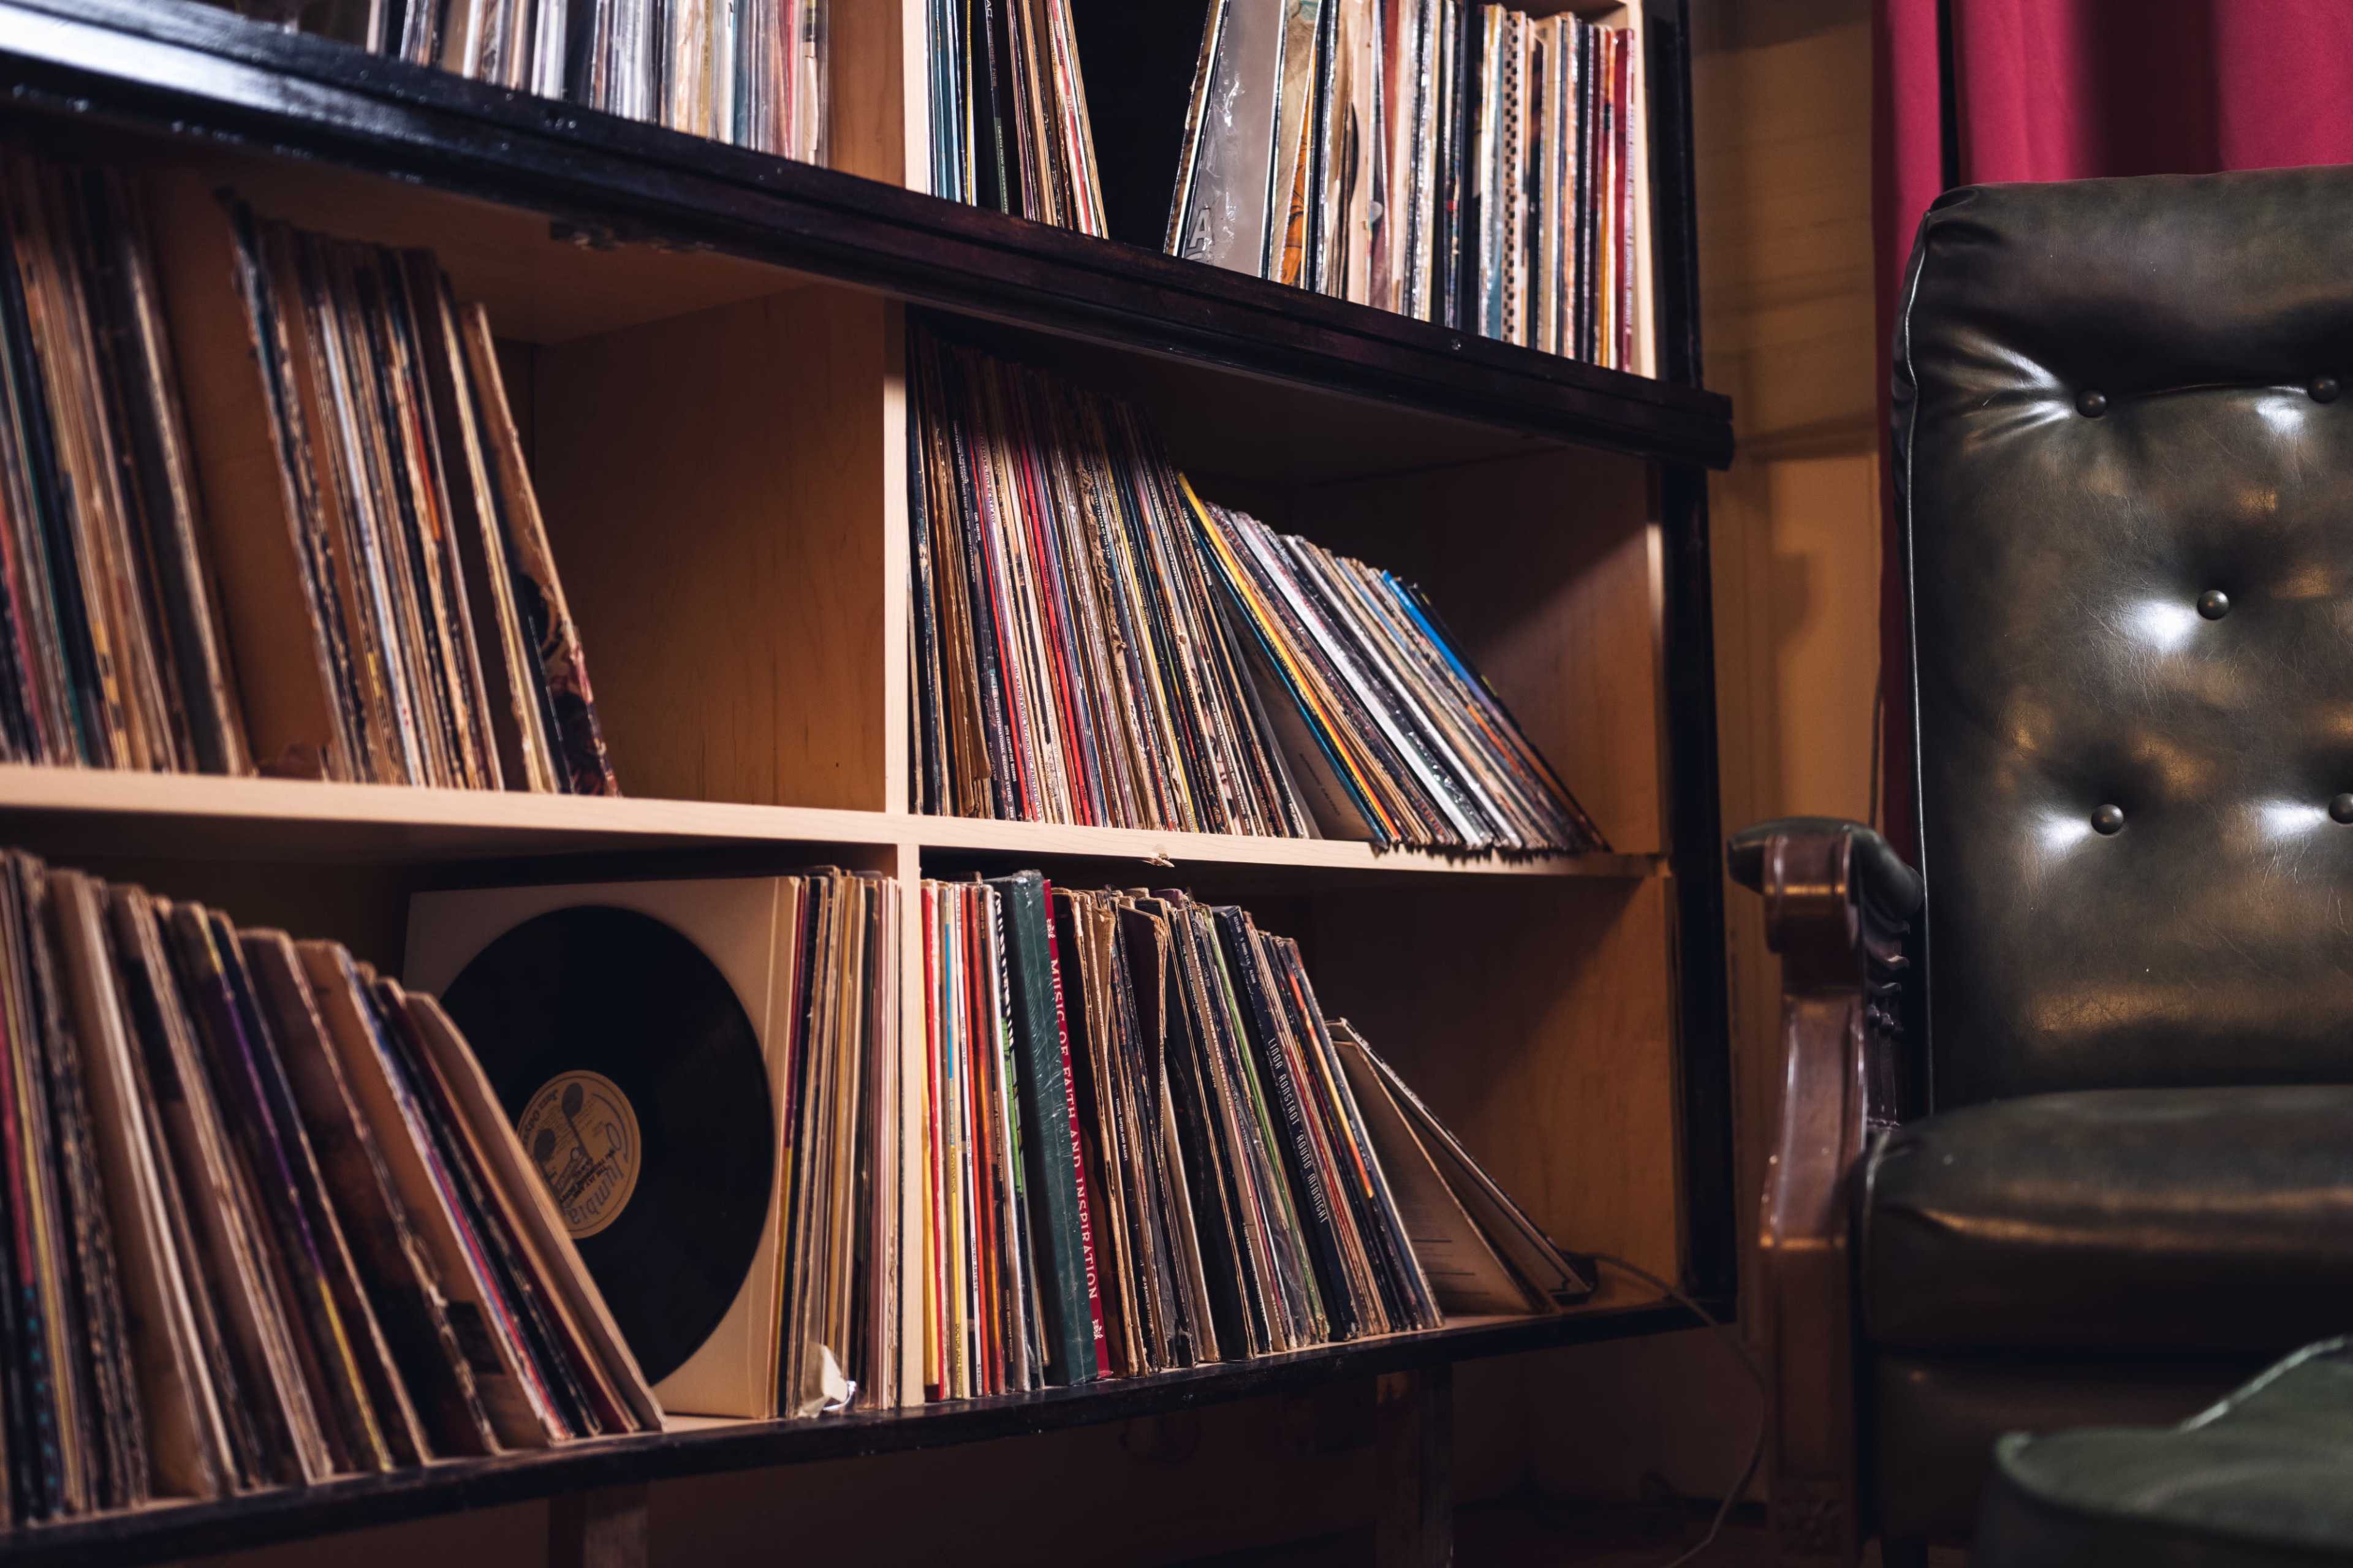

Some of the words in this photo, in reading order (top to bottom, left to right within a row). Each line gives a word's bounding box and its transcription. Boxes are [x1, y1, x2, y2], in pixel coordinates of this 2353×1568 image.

[1170, 561, 1181, 590] EVERYBODY
[1195, 548, 1205, 565] LOSING
[1204, 572, 1213, 586] MIND
[1136, 577, 1147, 607] COMPOSITE
[990, 673, 999, 711] PHILADELPHIA
[995, 711, 1005, 753] INTERNATIONAL
[1219, 735, 1233, 771] INTERNATIONAL
[1230, 772, 1240, 795] RECORDS
[1237, 795, 1246, 815] STEREO
[1050, 960, 1065, 1022] MUSIC
[1189, 980, 1198, 1003] JOHNSON
[1058, 1030, 1069, 1055] OF
[1062, 1067, 1075, 1118] FAITH
[1069, 1129, 1082, 1167] AND
[1267, 1037, 1284, 1070] LINDA
[1276, 1074, 1300, 1125] RONSTADT
[1306, 1173, 1328, 1224] MIDNIGHT
[1075, 1176, 1097, 1299] INSPIRATION
